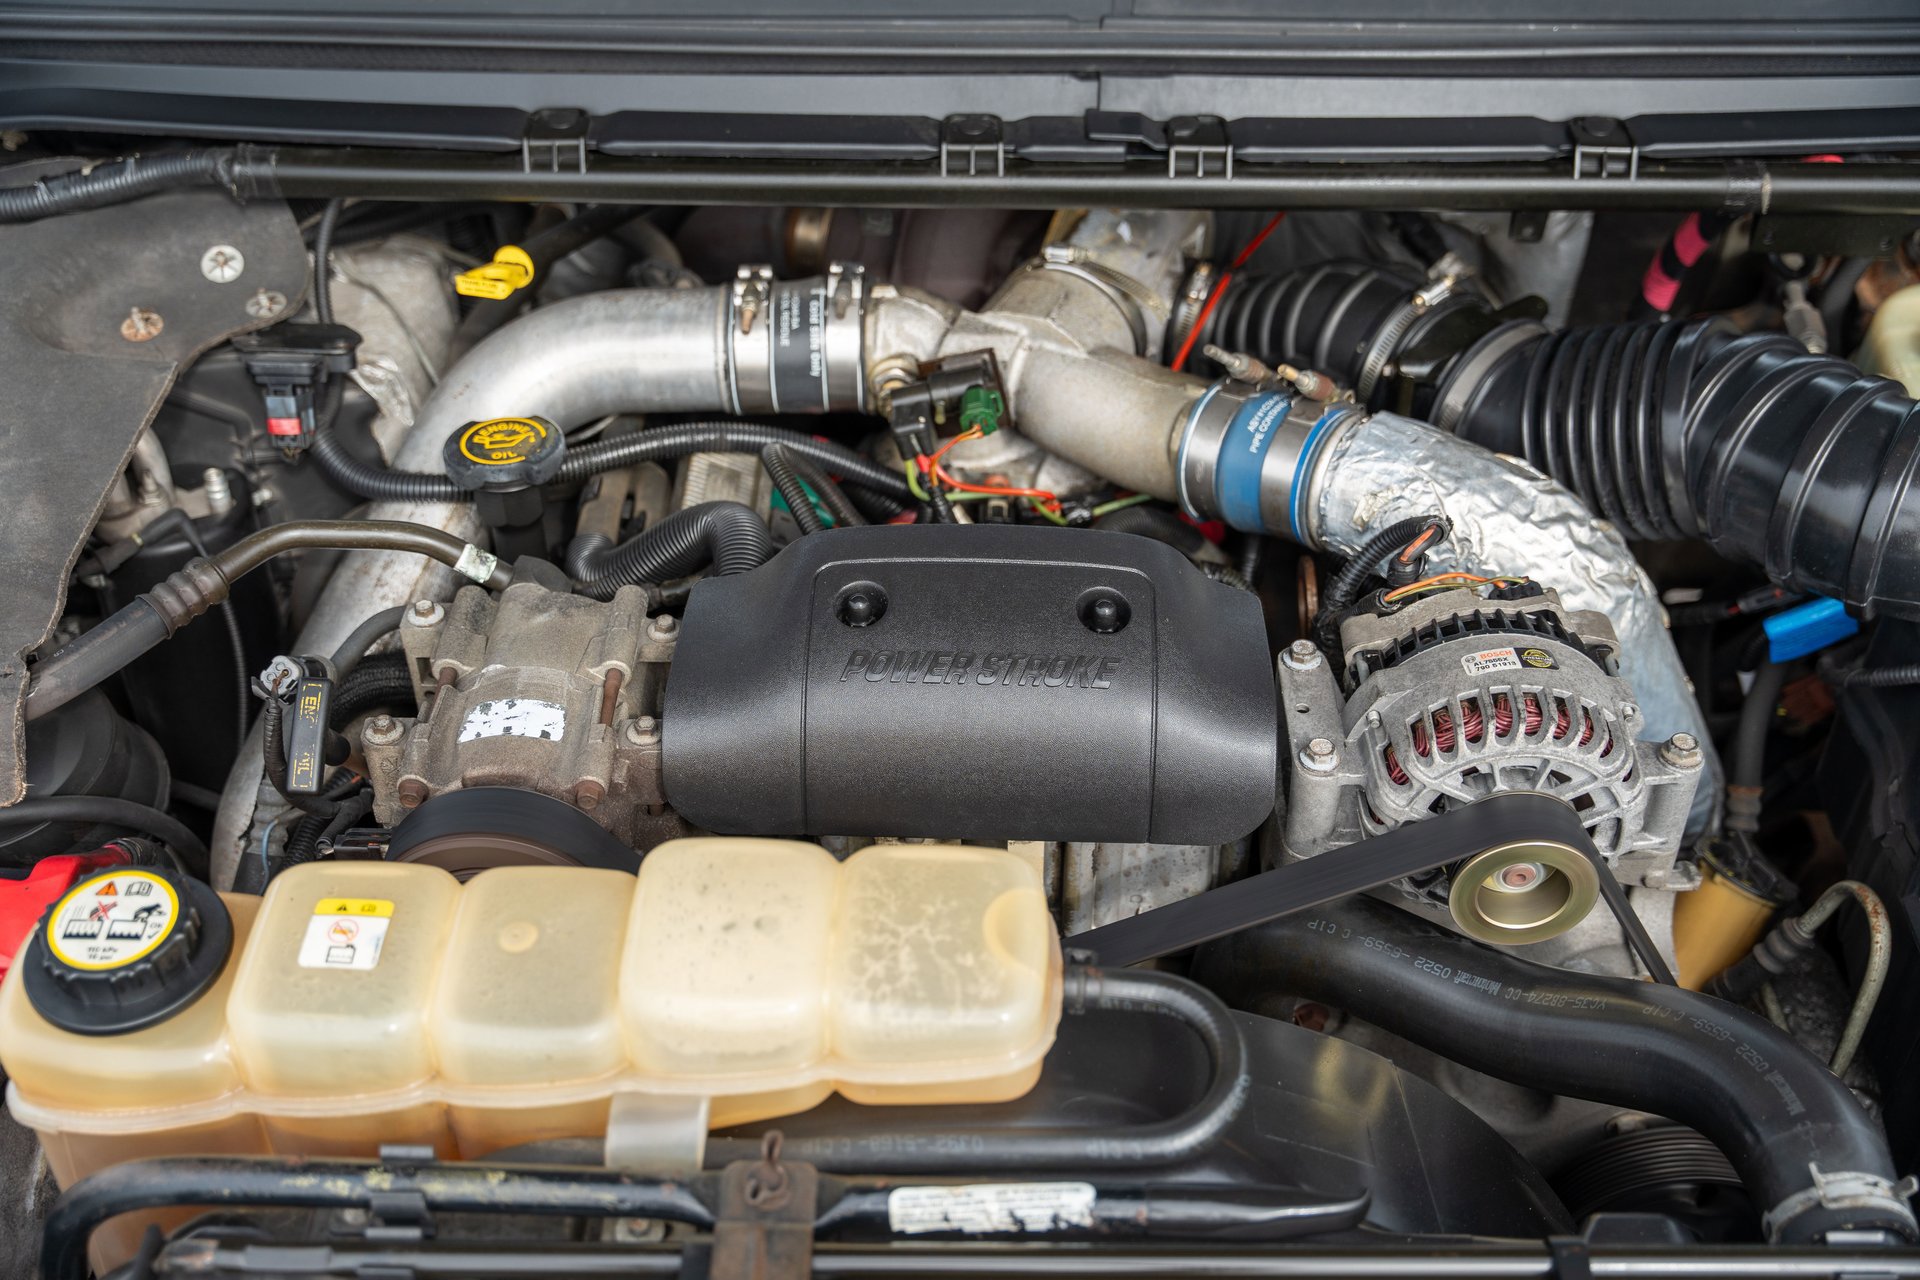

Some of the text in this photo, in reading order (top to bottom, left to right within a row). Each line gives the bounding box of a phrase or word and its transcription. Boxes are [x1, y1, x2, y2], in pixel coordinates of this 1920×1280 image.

[478, 422, 531, 437] ENGINE
[490, 450, 518, 460] OIL
[1479, 649, 1513, 660] BOSCH
[840, 649, 1121, 690] POWER STROKE
[1414, 956, 1452, 979] 0522
[1735, 1043, 1769, 1072] 0522
